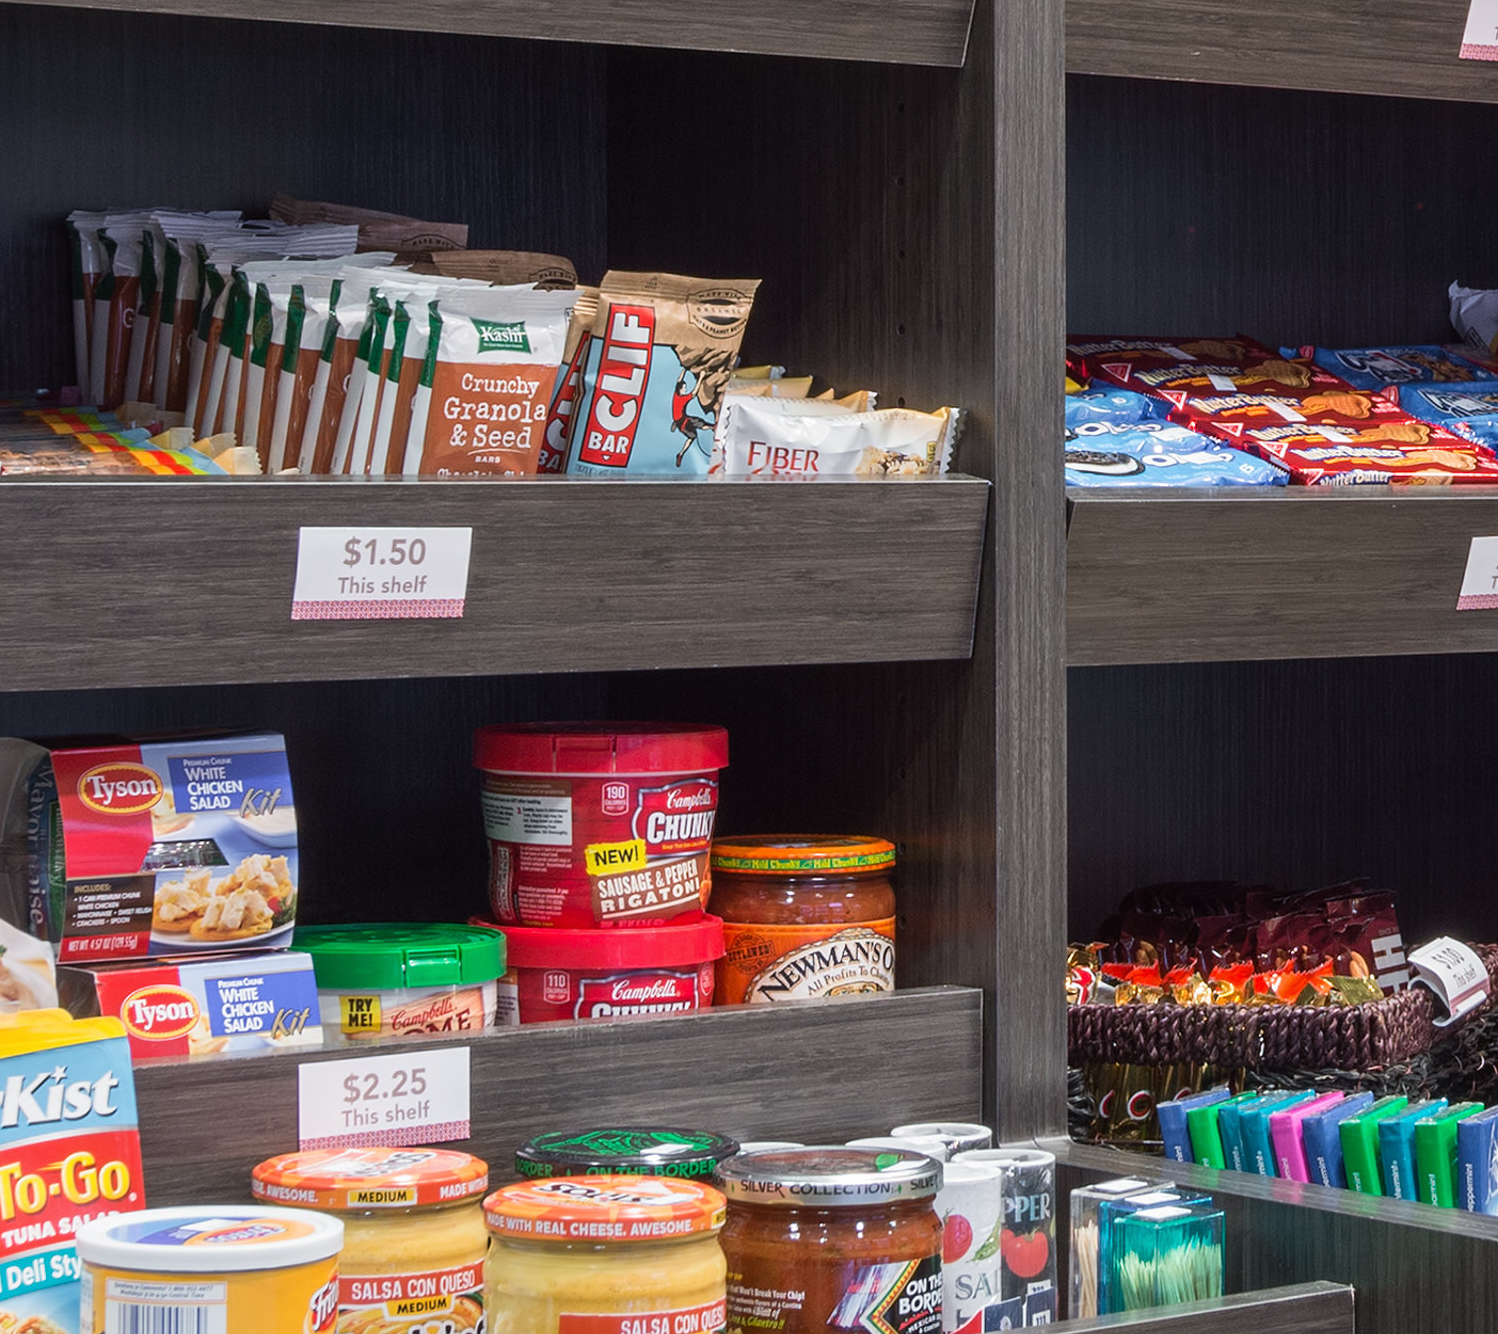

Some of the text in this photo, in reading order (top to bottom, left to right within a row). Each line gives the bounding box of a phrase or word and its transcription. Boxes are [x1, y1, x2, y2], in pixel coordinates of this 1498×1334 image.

[594, 312, 651, 432] CLIF
[460, 373, 540, 398] Crunchy
[443, 397, 547, 421] Granola
[472, 425, 531, 449] Seed
[587, 431, 629, 455] BAR
[747, 441, 820, 472] FIBER
[343, 536, 426, 568] $1.50
[338, 575, 428, 594] This shelf
[85, 775, 159, 806] Tyson
[187, 781, 243, 797] CHICKEN
[606, 785, 625, 799] 190
[594, 847, 640, 866] NEW!
[665, 859, 698, 884] PEPPER
[757, 940, 882, 1002] NEWMAN'S
[129, 998, 195, 1031] Tyson
[221, 1000, 274, 1016] CHICKEN
[348, 997, 373, 1013] TRY
[343, 1068, 428, 1105] $2.25
[341, 1100, 431, 1129] This shelf
[357, 1189, 407, 1204] MEDIUM
[739, 1180, 890, 1200] SILVER COLLECTION
[630, 1219, 694, 1236] AWESOME.
[351, 1270, 475, 1300] SALSA CON QUESO
[396, 1298, 447, 1315] MEDIUM
[673, 1312, 699, 1334] CON
